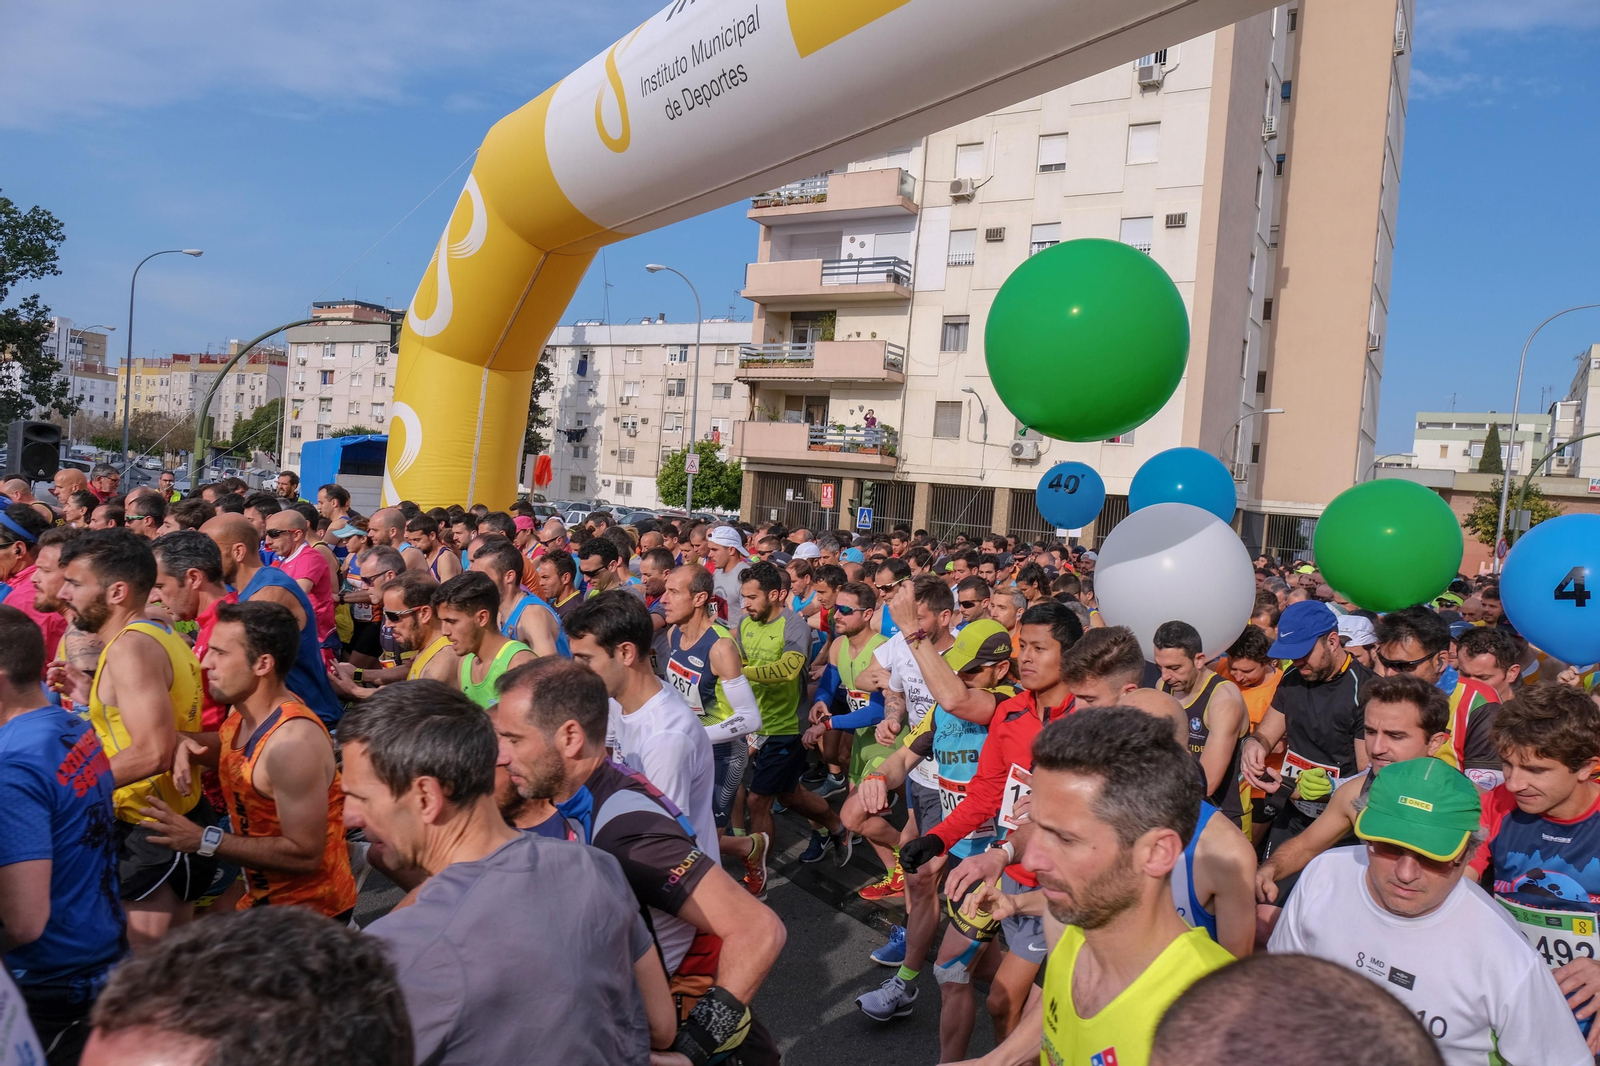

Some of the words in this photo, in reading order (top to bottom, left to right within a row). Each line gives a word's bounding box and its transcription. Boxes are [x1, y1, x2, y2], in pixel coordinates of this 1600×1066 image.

[640, 56, 688, 98] Instituto
[691, 4, 761, 68] Municipal
[665, 98, 683, 121] de
[681, 63, 748, 111] Deportes
[755, 652, 803, 679] ITALICA
[671, 673, 692, 697] 267
[1408, 799, 1432, 810] ONCE
[1369, 956, 1385, 969] IMD
[1521, 931, 1595, 967] 492
